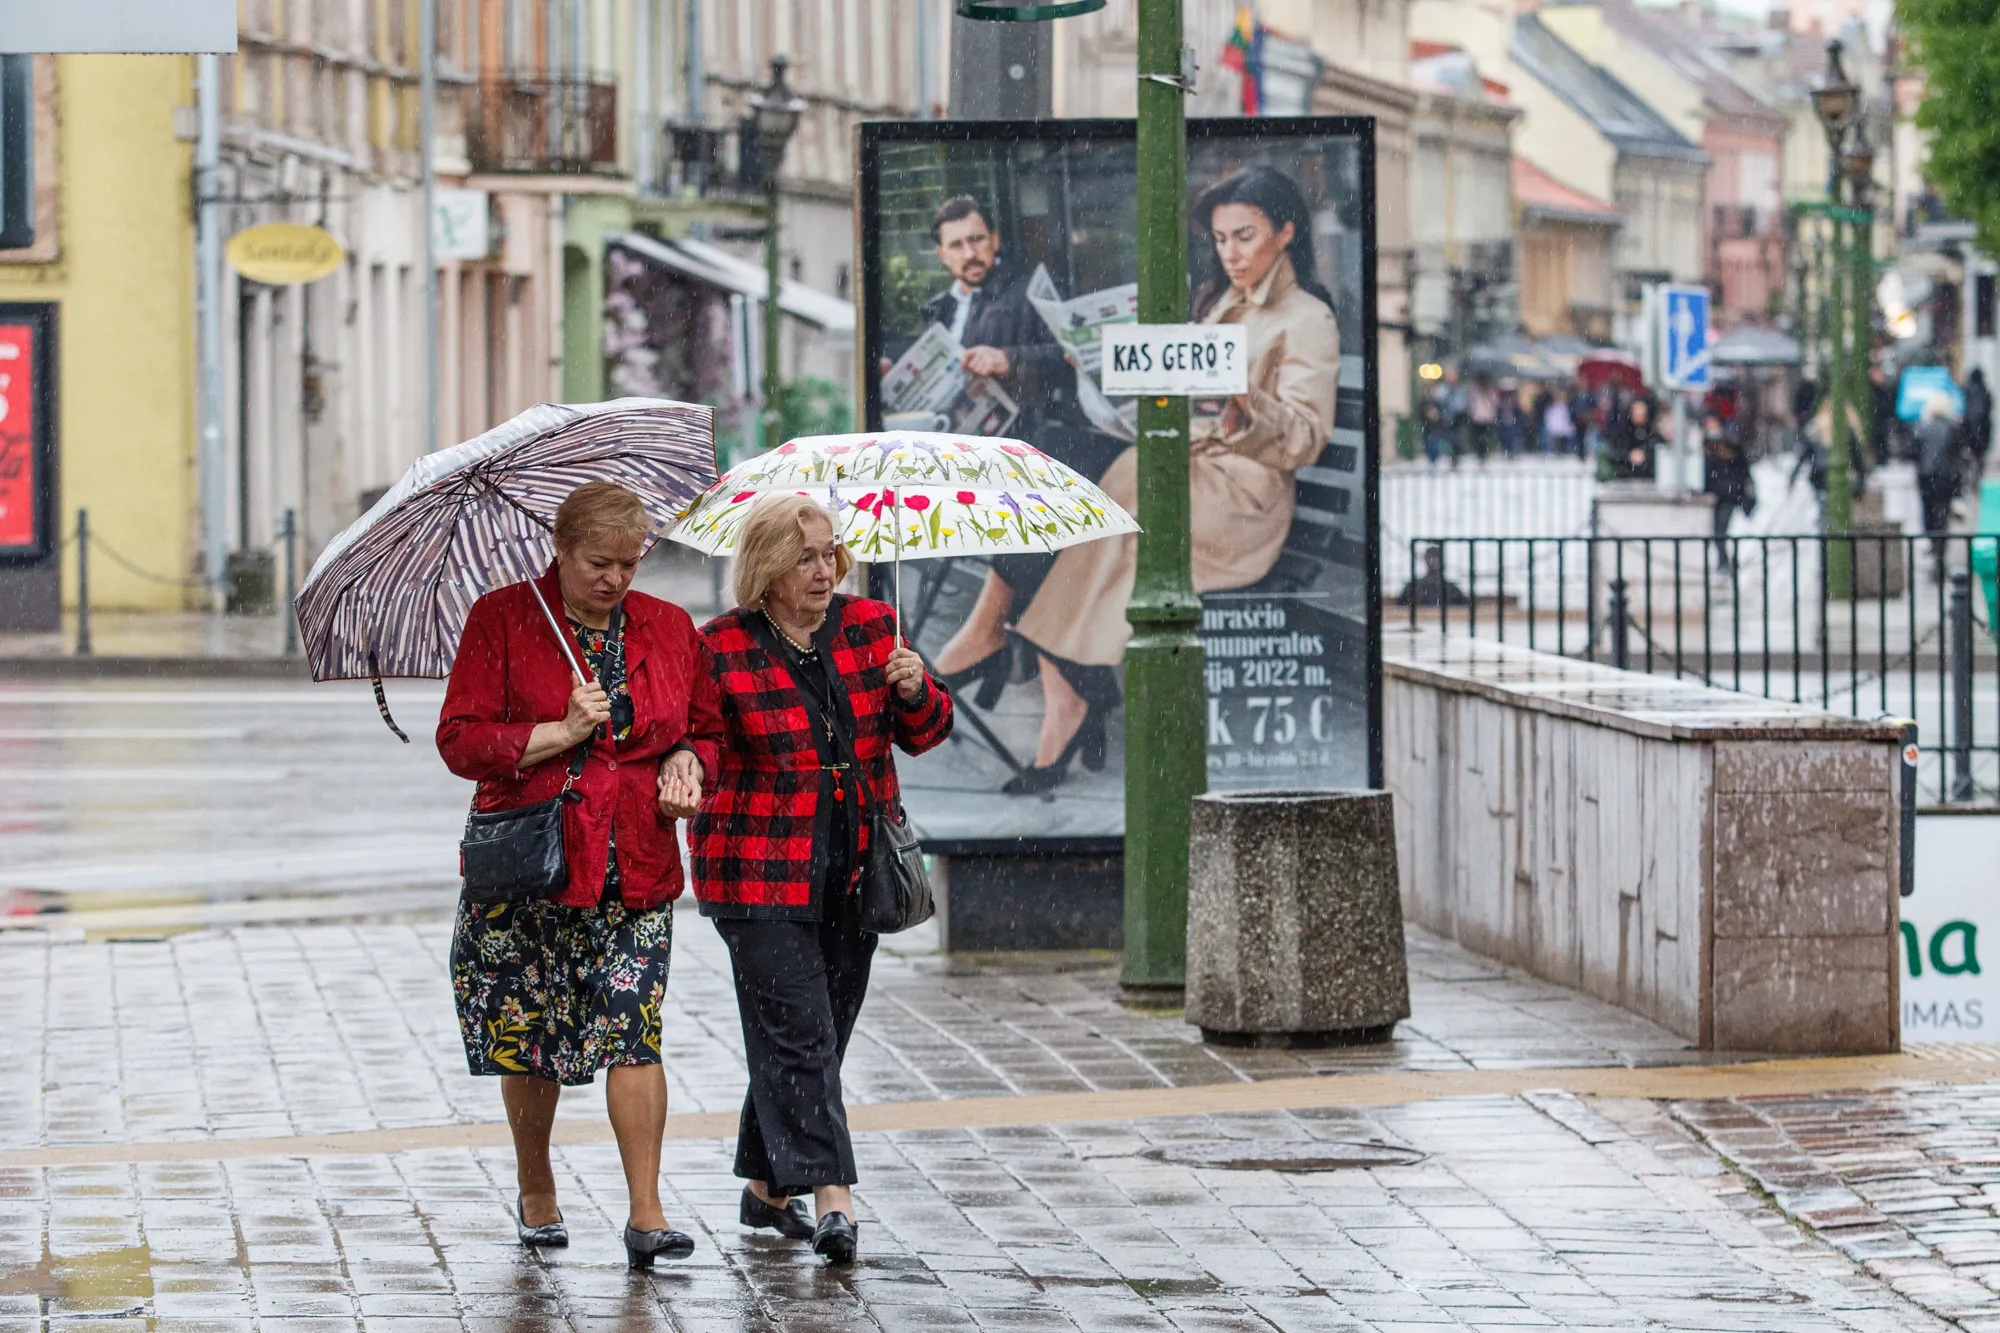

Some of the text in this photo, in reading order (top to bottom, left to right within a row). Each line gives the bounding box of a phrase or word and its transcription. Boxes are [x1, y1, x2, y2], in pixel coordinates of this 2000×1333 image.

[1114, 342, 1153, 372] KAS
[1203, 659, 1332, 693] ija 2022 m.
[1246, 696, 1297, 745] 75
[1904, 1000, 1983, 1030] IMAS
